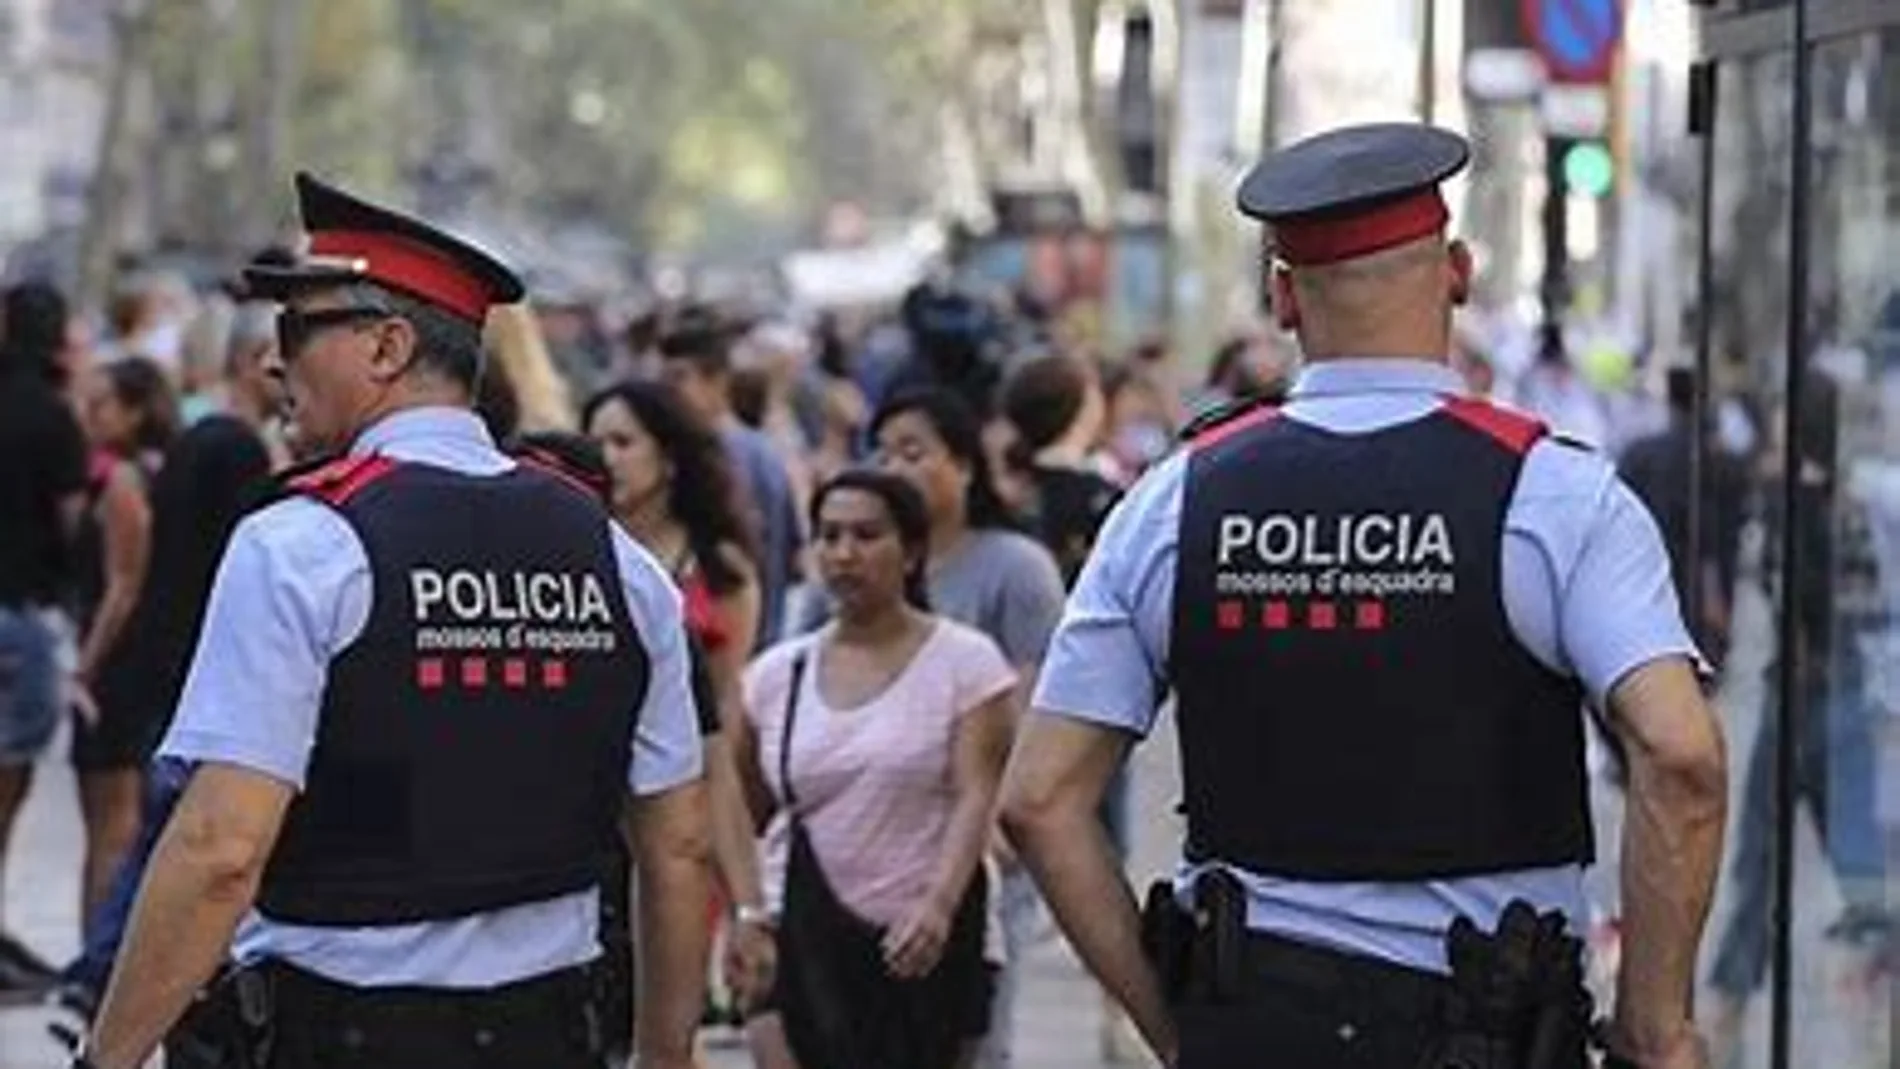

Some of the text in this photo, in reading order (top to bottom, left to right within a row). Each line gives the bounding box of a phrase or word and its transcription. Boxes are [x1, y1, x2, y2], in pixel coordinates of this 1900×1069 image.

[1217, 513, 1453, 565] POLICIA
[412, 569, 611, 624] POLICIA
[1216, 572, 1310, 594] mossos
[417, 627, 501, 651] mossos
